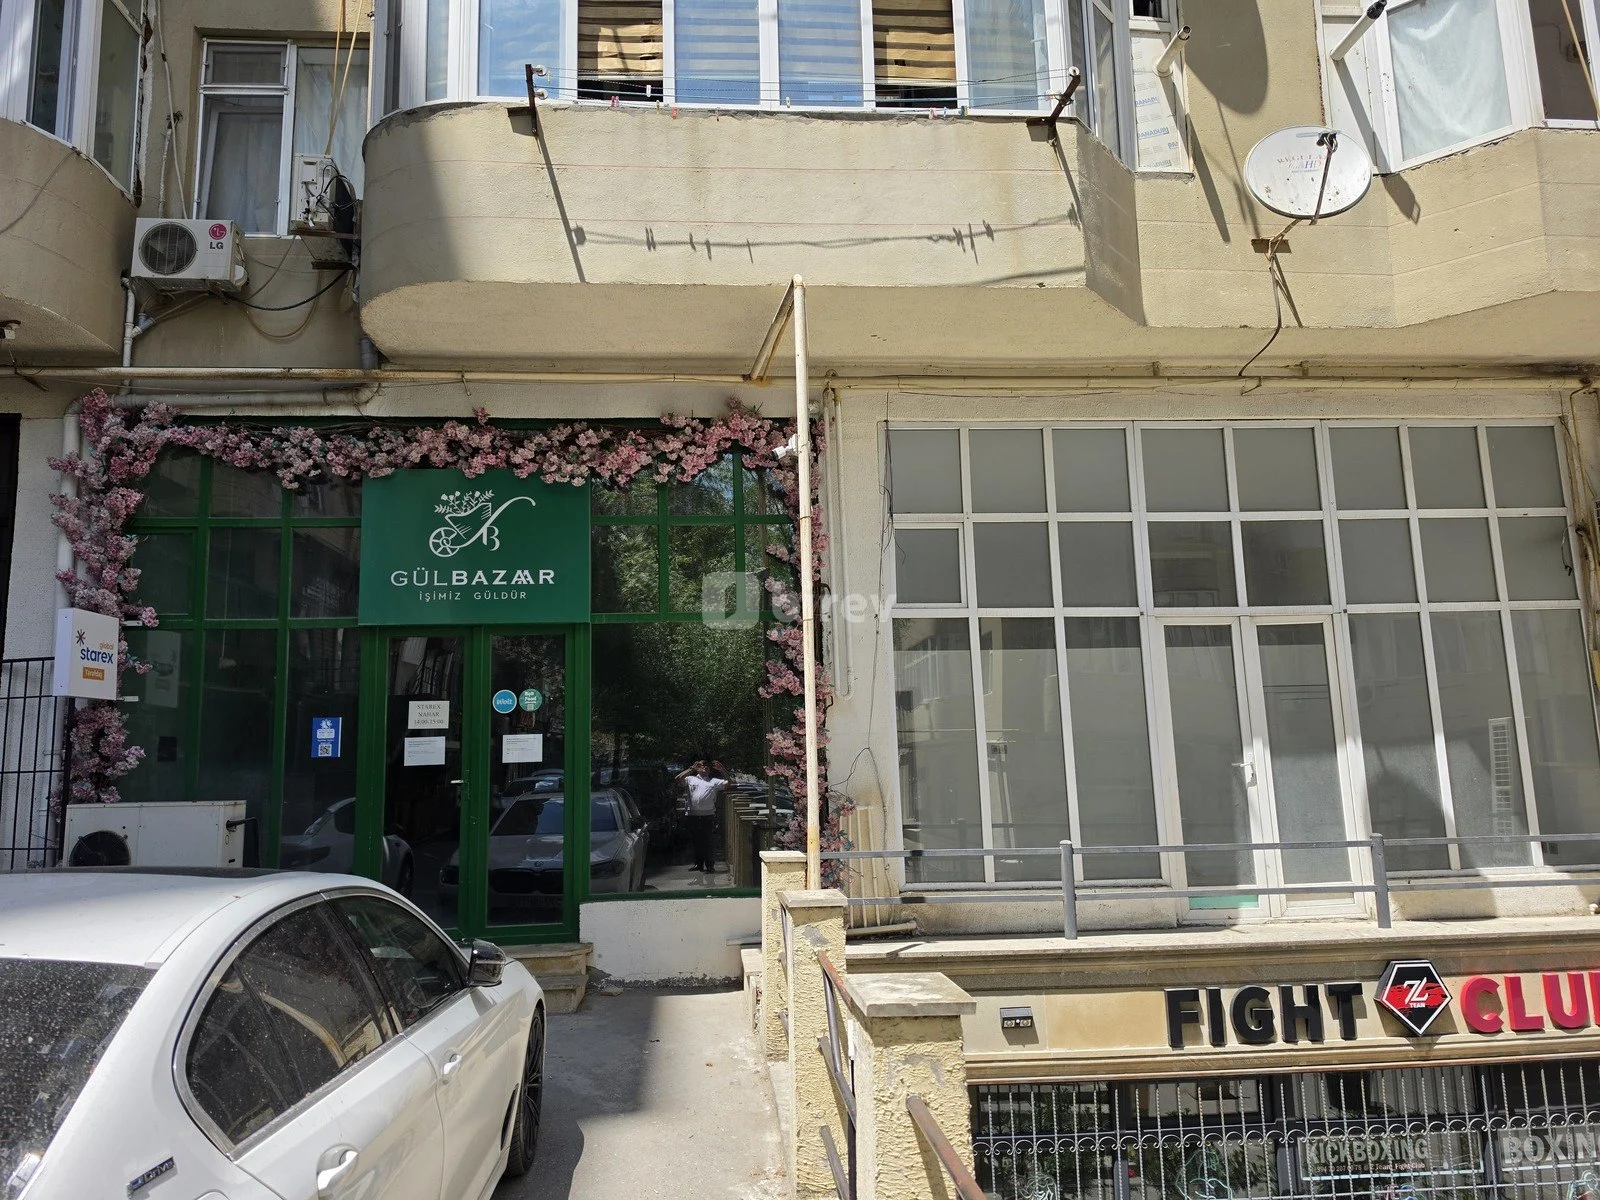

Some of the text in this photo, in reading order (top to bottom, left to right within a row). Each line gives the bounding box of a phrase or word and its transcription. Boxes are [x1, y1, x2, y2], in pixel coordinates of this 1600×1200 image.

[209, 241, 224, 250] LG
[419, 590, 527, 602] İŞİMİZ GÜLDÜR
[100, 642, 115, 651] global
[80, 647, 114, 664] starex
[1164, 970, 1600, 1048] FIGHT CLU
[1308, 1138, 1429, 1164] KICKBOXING
[1502, 1131, 1600, 1164] BOXIN
